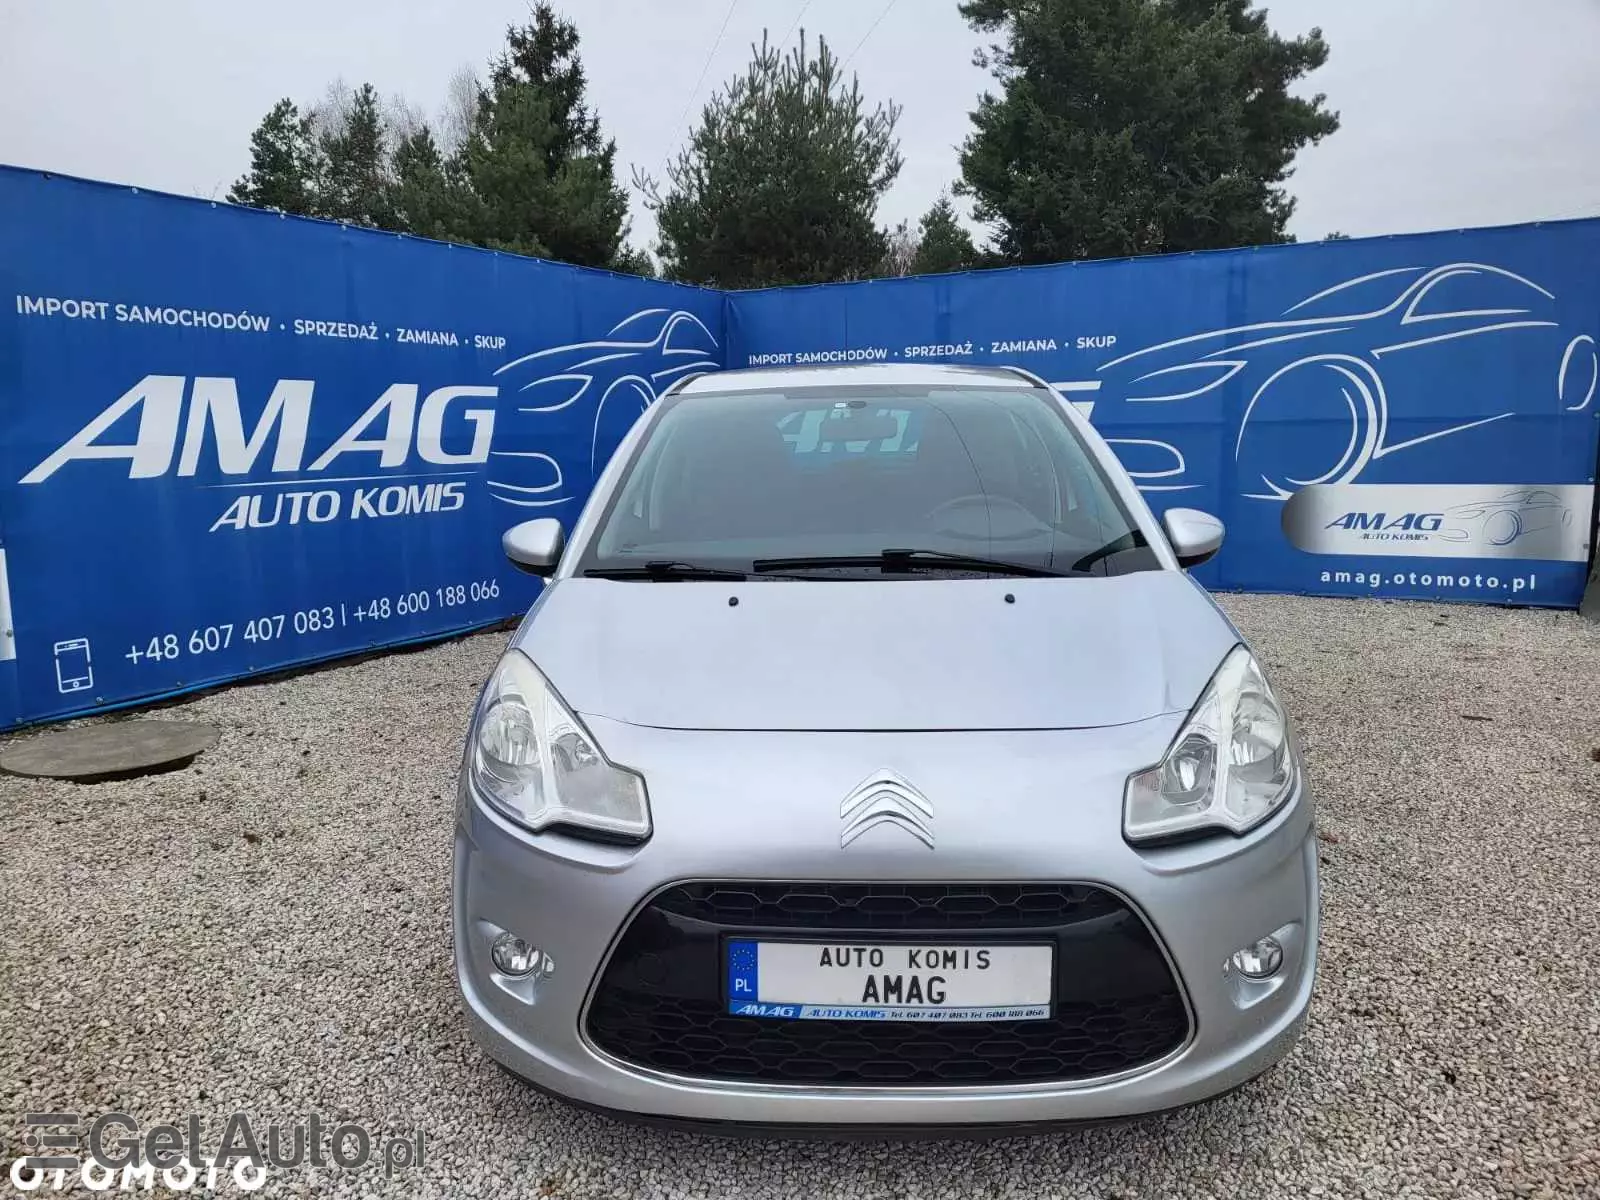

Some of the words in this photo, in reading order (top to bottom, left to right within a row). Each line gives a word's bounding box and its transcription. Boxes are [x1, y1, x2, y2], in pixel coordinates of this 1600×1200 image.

[15, 295, 109, 321] IMPORT
[114, 303, 271, 333] SAMOCHODÓW
[293, 318, 379, 341] SPRZEDAŻ
[396, 327, 459, 347] ZAMIANA
[474, 335, 507, 350] SKUP
[748, 352, 793, 366] IMPORT
[795, 347, 888, 363] SAMOCHODÓW
[904, 340, 974, 357] SPRZEDAŻ
[991, 339, 1058, 353] ZAMIANA
[1076, 335, 1118, 351] SKUP
[208, 494, 342, 533] AUTO
[350, 481, 467, 520] KOMIS
[1323, 512, 1445, 531] AMAG
[1320, 569, 1536, 592] amag.otomoto.pl
[125, 634, 180, 667] +48
[188, 624, 234, 655] 607
[243, 615, 285, 645] 407
[293, 606, 335, 635] 083
[352, 597, 392, 623] +48
[396, 590, 430, 615] 600
[435, 584, 467, 608] 188
[469, 578, 501, 601] 066
[819, 947, 884, 968] AUTO
[908, 949, 991, 970] KOMIS
[735, 978, 752, 992] PL
[861, 975, 947, 1005] AMAG
[735, 1004, 795, 1017] AMAG
[807, 1008, 841, 1018] AUTO
[844, 1009, 886, 1019] KOMIS
